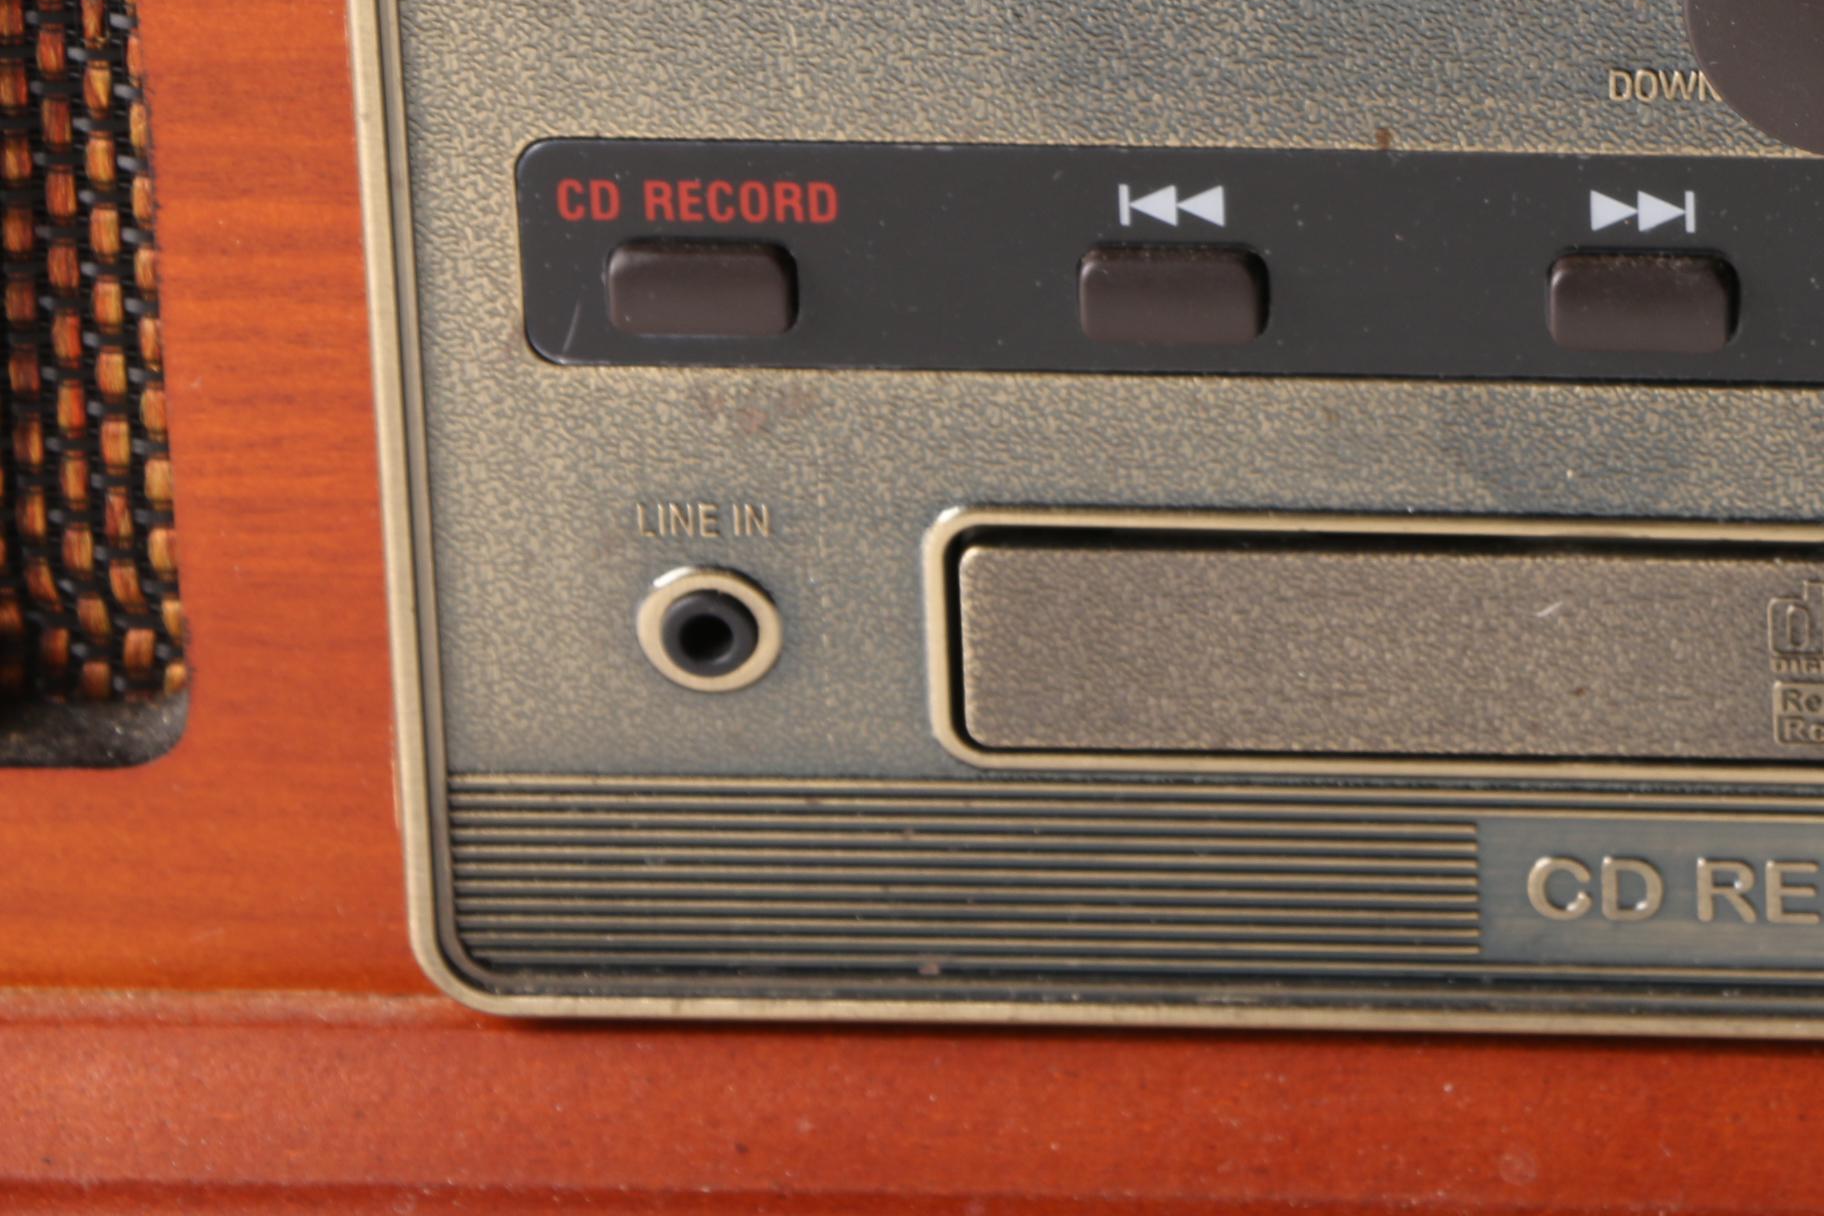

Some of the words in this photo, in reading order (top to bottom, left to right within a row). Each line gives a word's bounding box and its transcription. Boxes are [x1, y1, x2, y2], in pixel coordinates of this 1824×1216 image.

[556, 178, 622, 222] CD
[643, 180, 839, 224] RECORD
[635, 503, 720, 538] LINE
[732, 504, 772, 538] IN
[1525, 855, 1664, 922] CD
